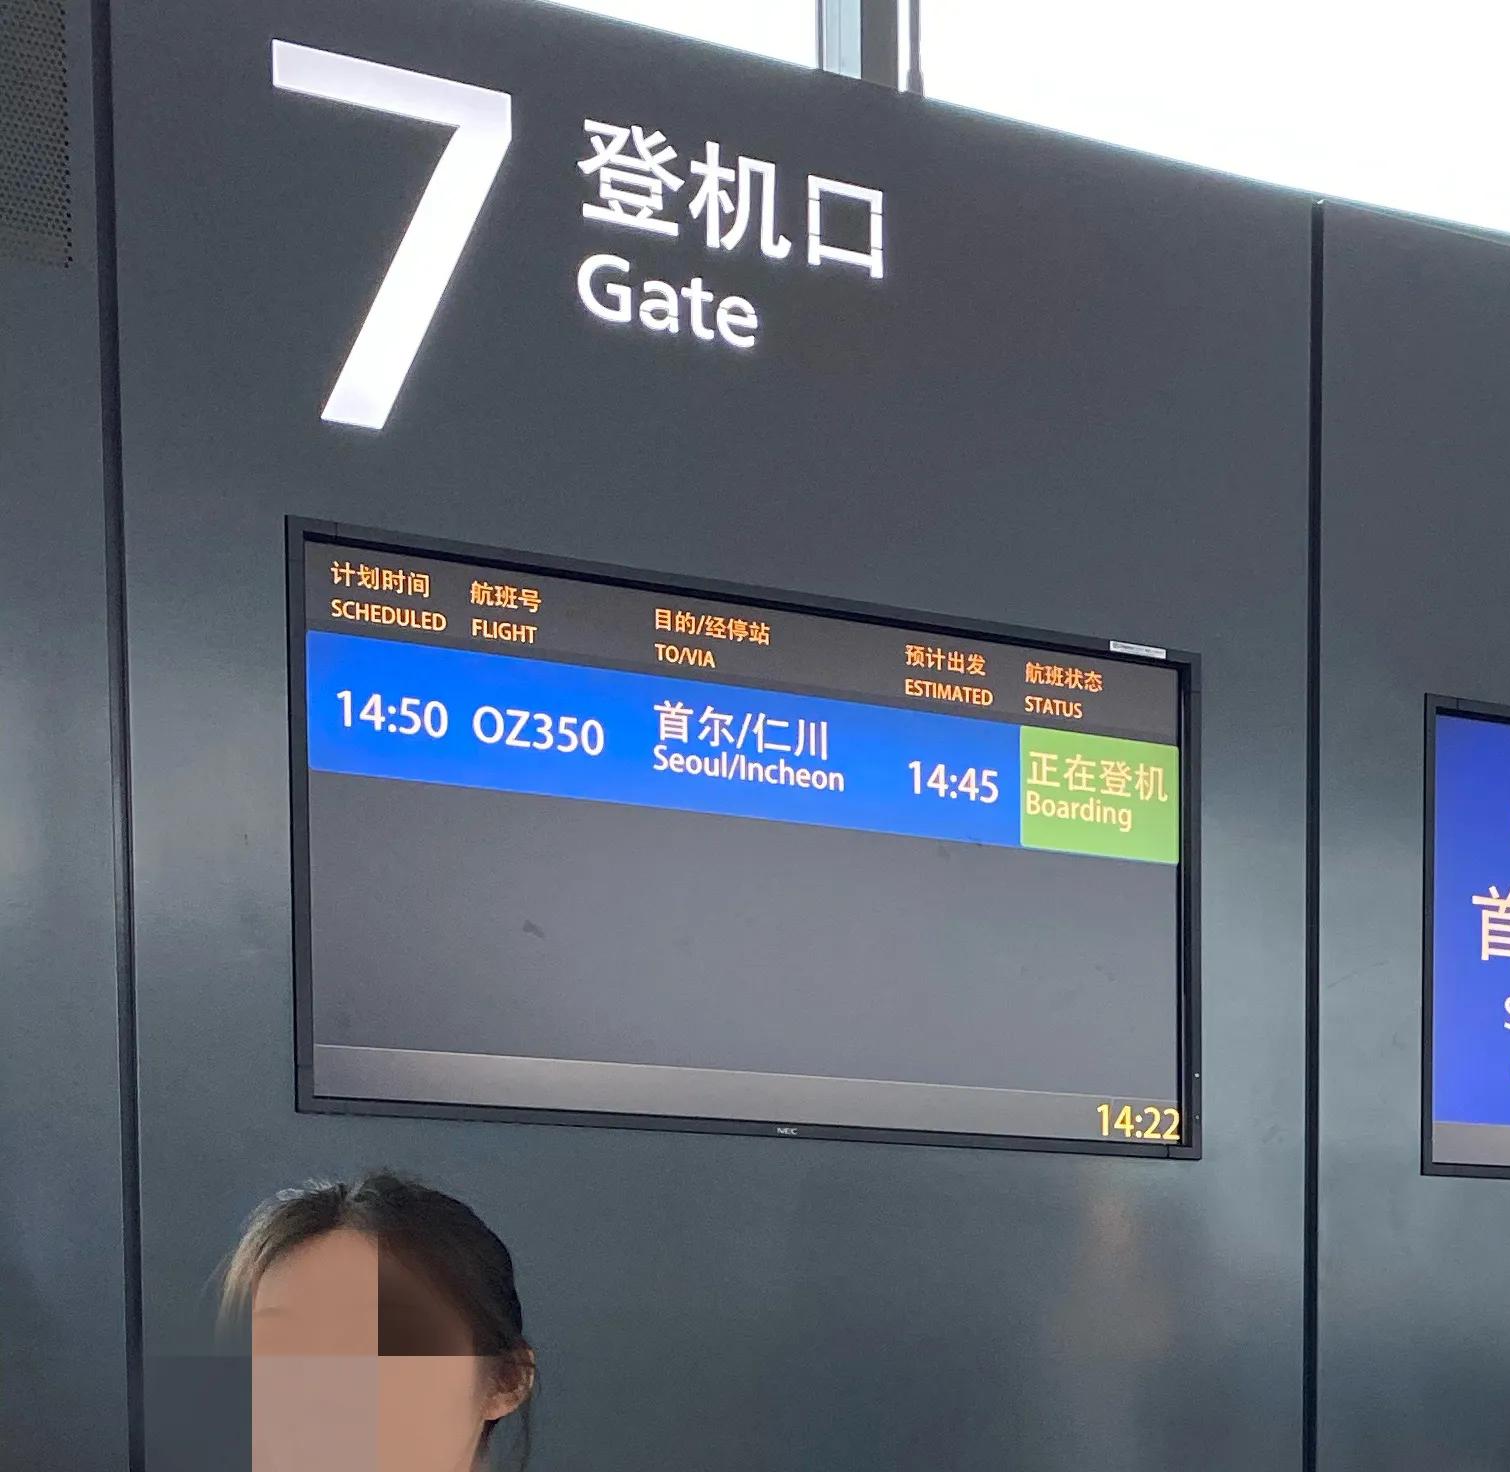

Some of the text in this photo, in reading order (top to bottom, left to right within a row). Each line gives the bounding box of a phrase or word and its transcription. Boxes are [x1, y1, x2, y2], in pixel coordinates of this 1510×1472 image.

[577, 118, 885, 280] 登机口
[271, 38, 512, 430] 7
[576, 254, 759, 349] Gate
[330, 561, 430, 598] 计划时间
[470, 580, 542, 614] 航班号
[331, 599, 447, 632] SCHEDULED
[471, 618, 538, 644] FLIGHT
[655, 607, 770, 646] 目的/经停站
[655, 643, 716, 669] TO/VIA
[904, 644, 986, 677] 预计出发
[904, 678, 994, 707] ESTIMATED
[1024, 661, 1104, 693] 航班状态
[335, 689, 605, 757] 14:50 OZ350
[1024, 695, 1083, 719] STATUS
[653, 700, 829, 762] 首尔/仁川
[652, 744, 845, 793] Seoul/Incheon
[907, 760, 1000, 804] 14:45
[1025, 750, 1169, 803] 正在登机
[1025, 790, 1133, 833] Boarding
[1096, 1103, 1181, 1141] 14:22
